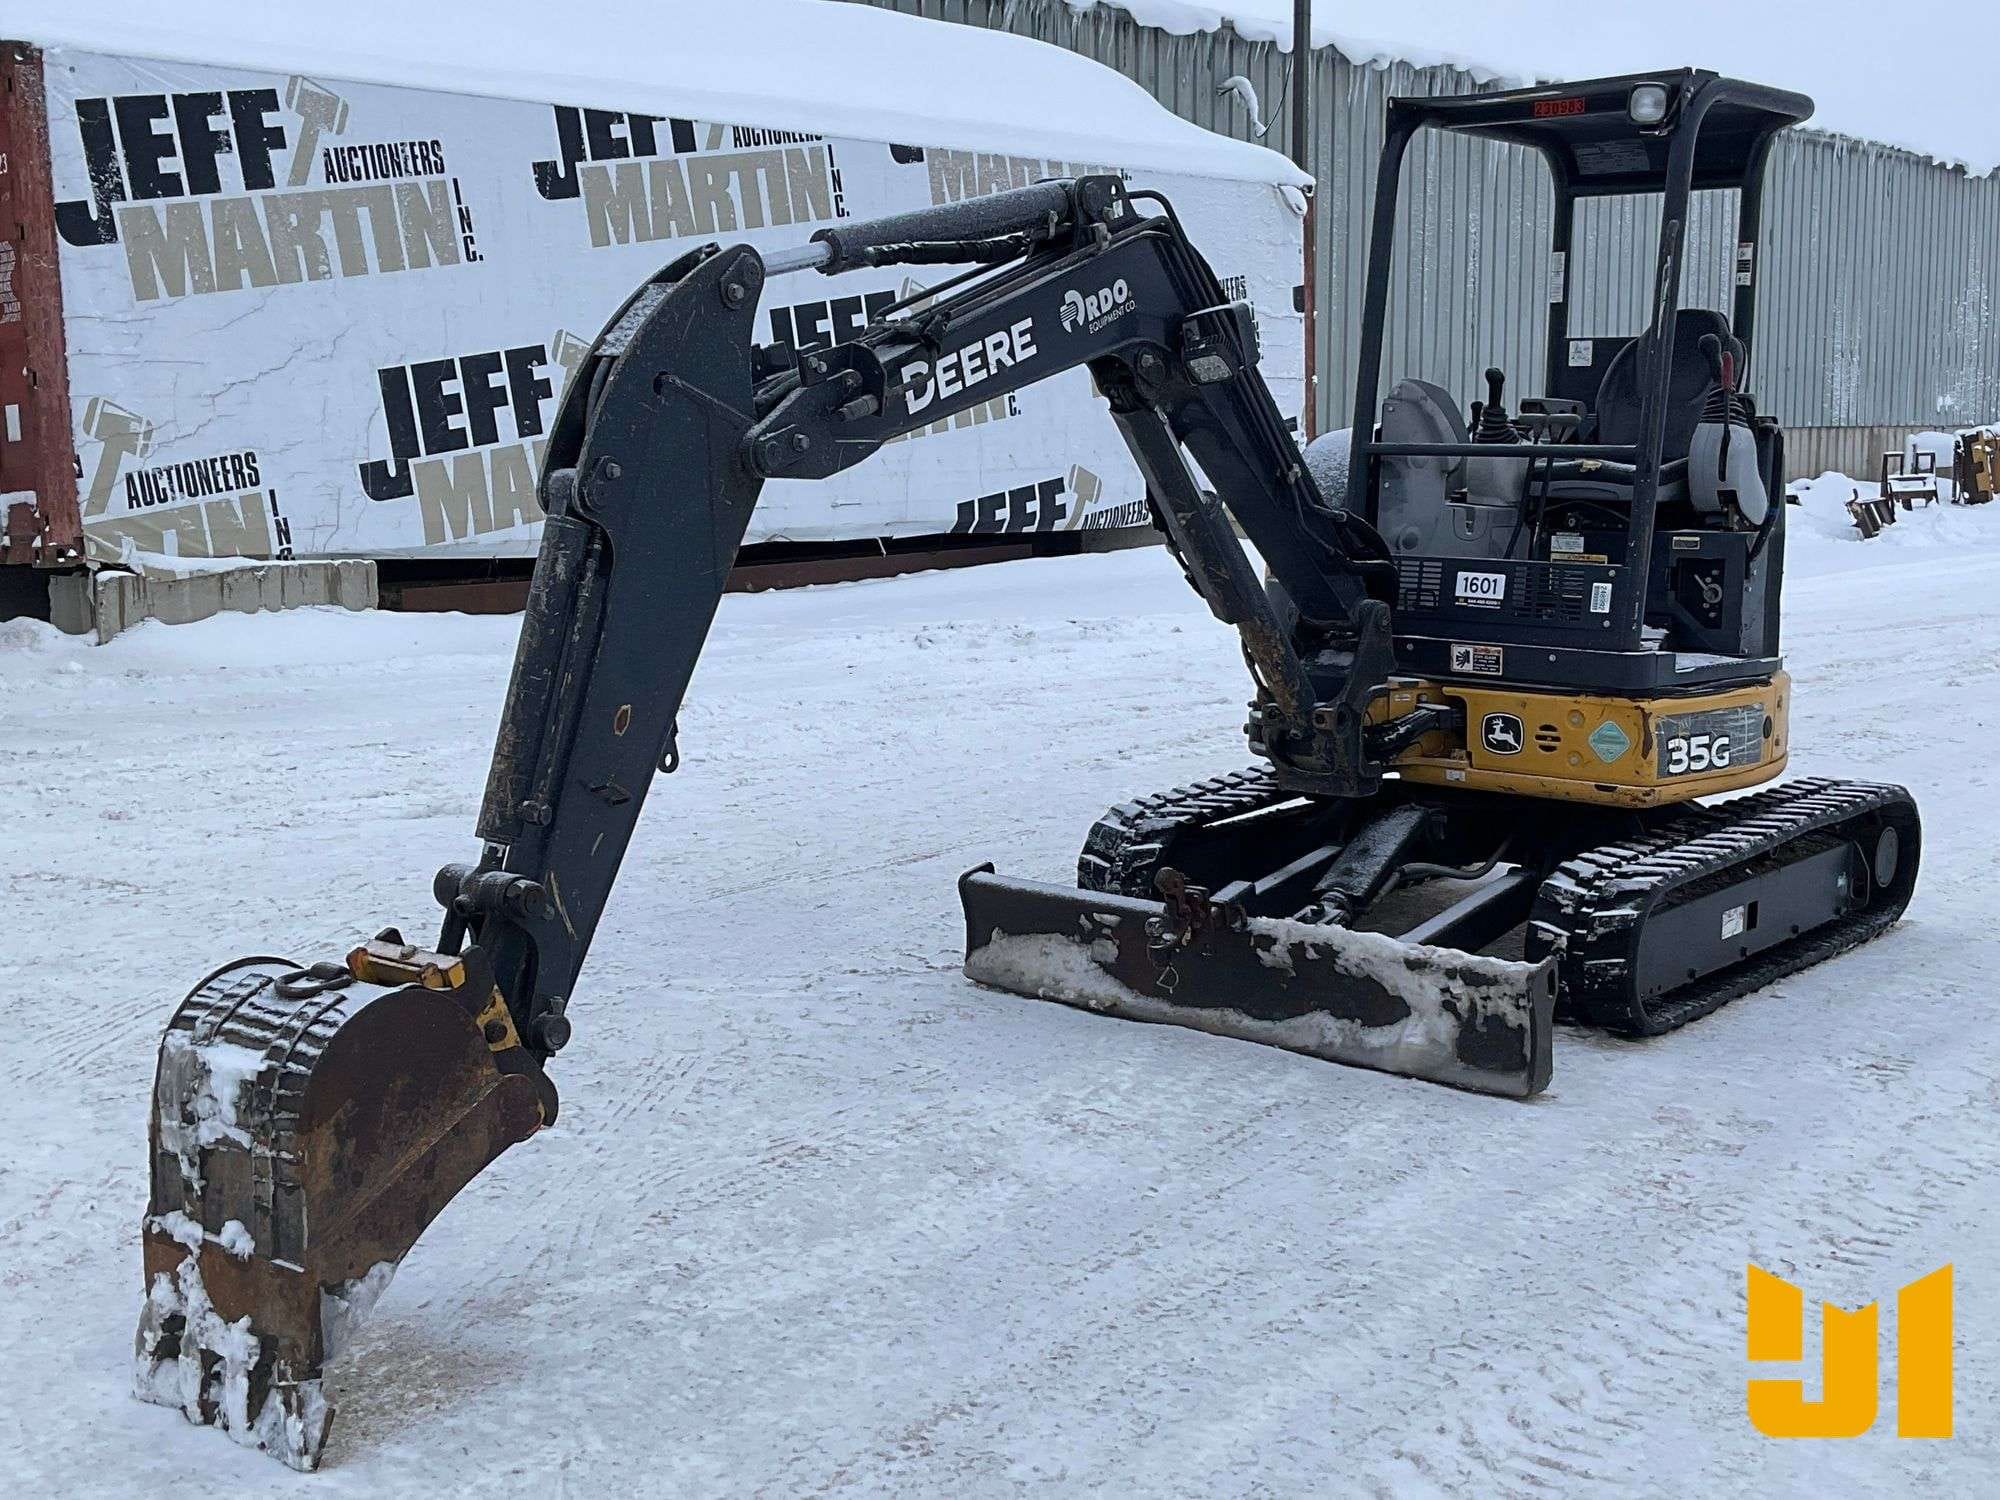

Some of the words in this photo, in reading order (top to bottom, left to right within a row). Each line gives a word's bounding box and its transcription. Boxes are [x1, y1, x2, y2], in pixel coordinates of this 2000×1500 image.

[54, 88, 287, 247] JEFF
[323, 139, 446, 184] AUCTIONEERS
[580, 146, 833, 248] MARTIN
[119, 179, 461, 301] MARTIN
[901, 317, 1038, 415] DEERE
[358, 343, 553, 502] JEFF
[124, 450, 261, 510] AUCTIONEERS
[1463, 576, 1498, 595] 1601
[1667, 735, 1730, 774] 35G
